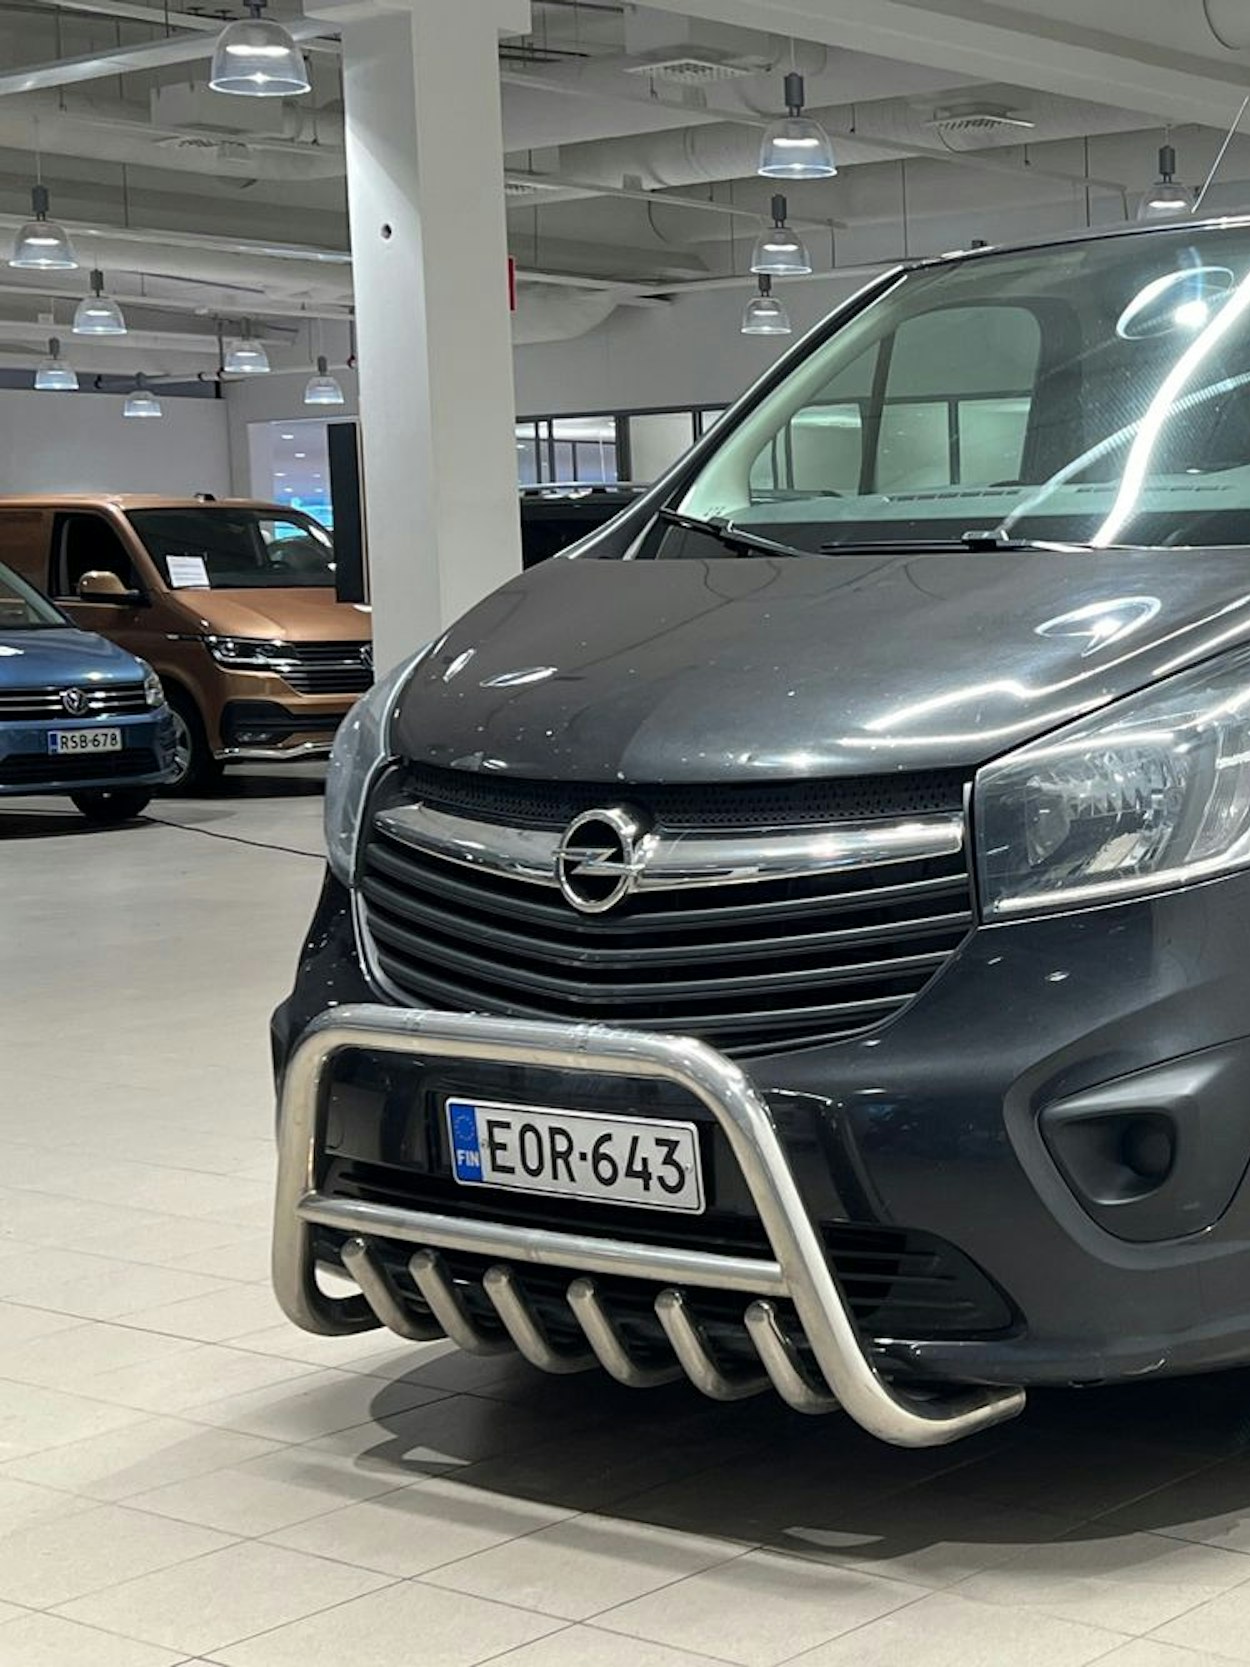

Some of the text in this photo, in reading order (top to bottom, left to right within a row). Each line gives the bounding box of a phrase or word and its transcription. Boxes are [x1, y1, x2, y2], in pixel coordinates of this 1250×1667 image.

[61, 733, 118, 750] RSB-678
[457, 1149, 480, 1168] FIN
[487, 1119, 686, 1194] EOR-643
